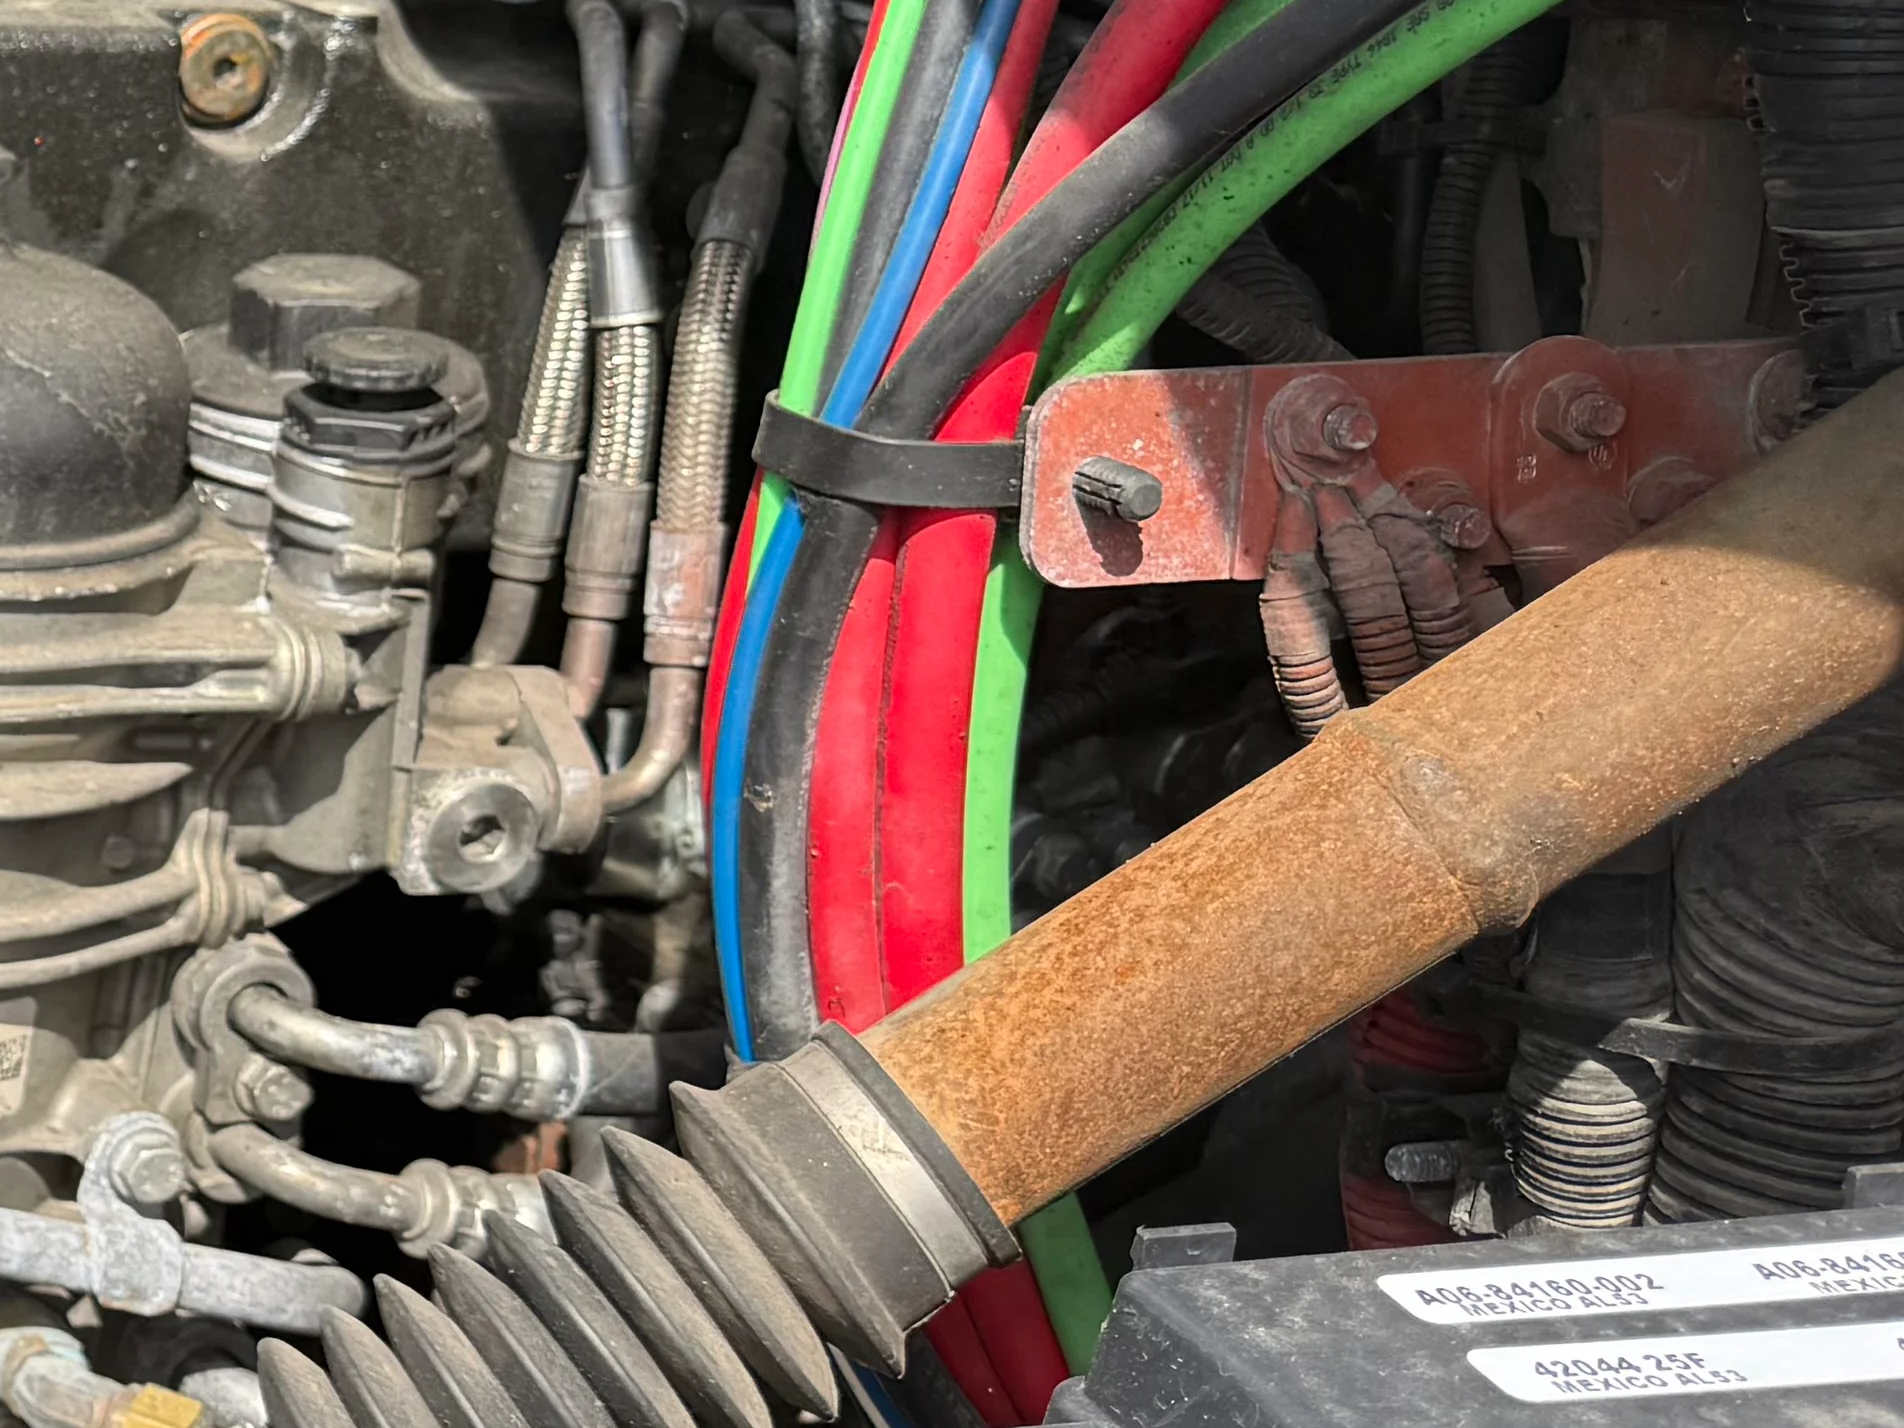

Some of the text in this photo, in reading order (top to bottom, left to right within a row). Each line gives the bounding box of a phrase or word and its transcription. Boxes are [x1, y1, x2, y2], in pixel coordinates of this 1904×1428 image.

[1414, 1273, 1665, 1307] A06-84160-002
[1457, 1275, 1904, 1318] MEXICO AL53 MEXIC
[1533, 1352, 1706, 1379] 42044 25F
[1551, 1369, 1749, 1395] MEXICO AL53
